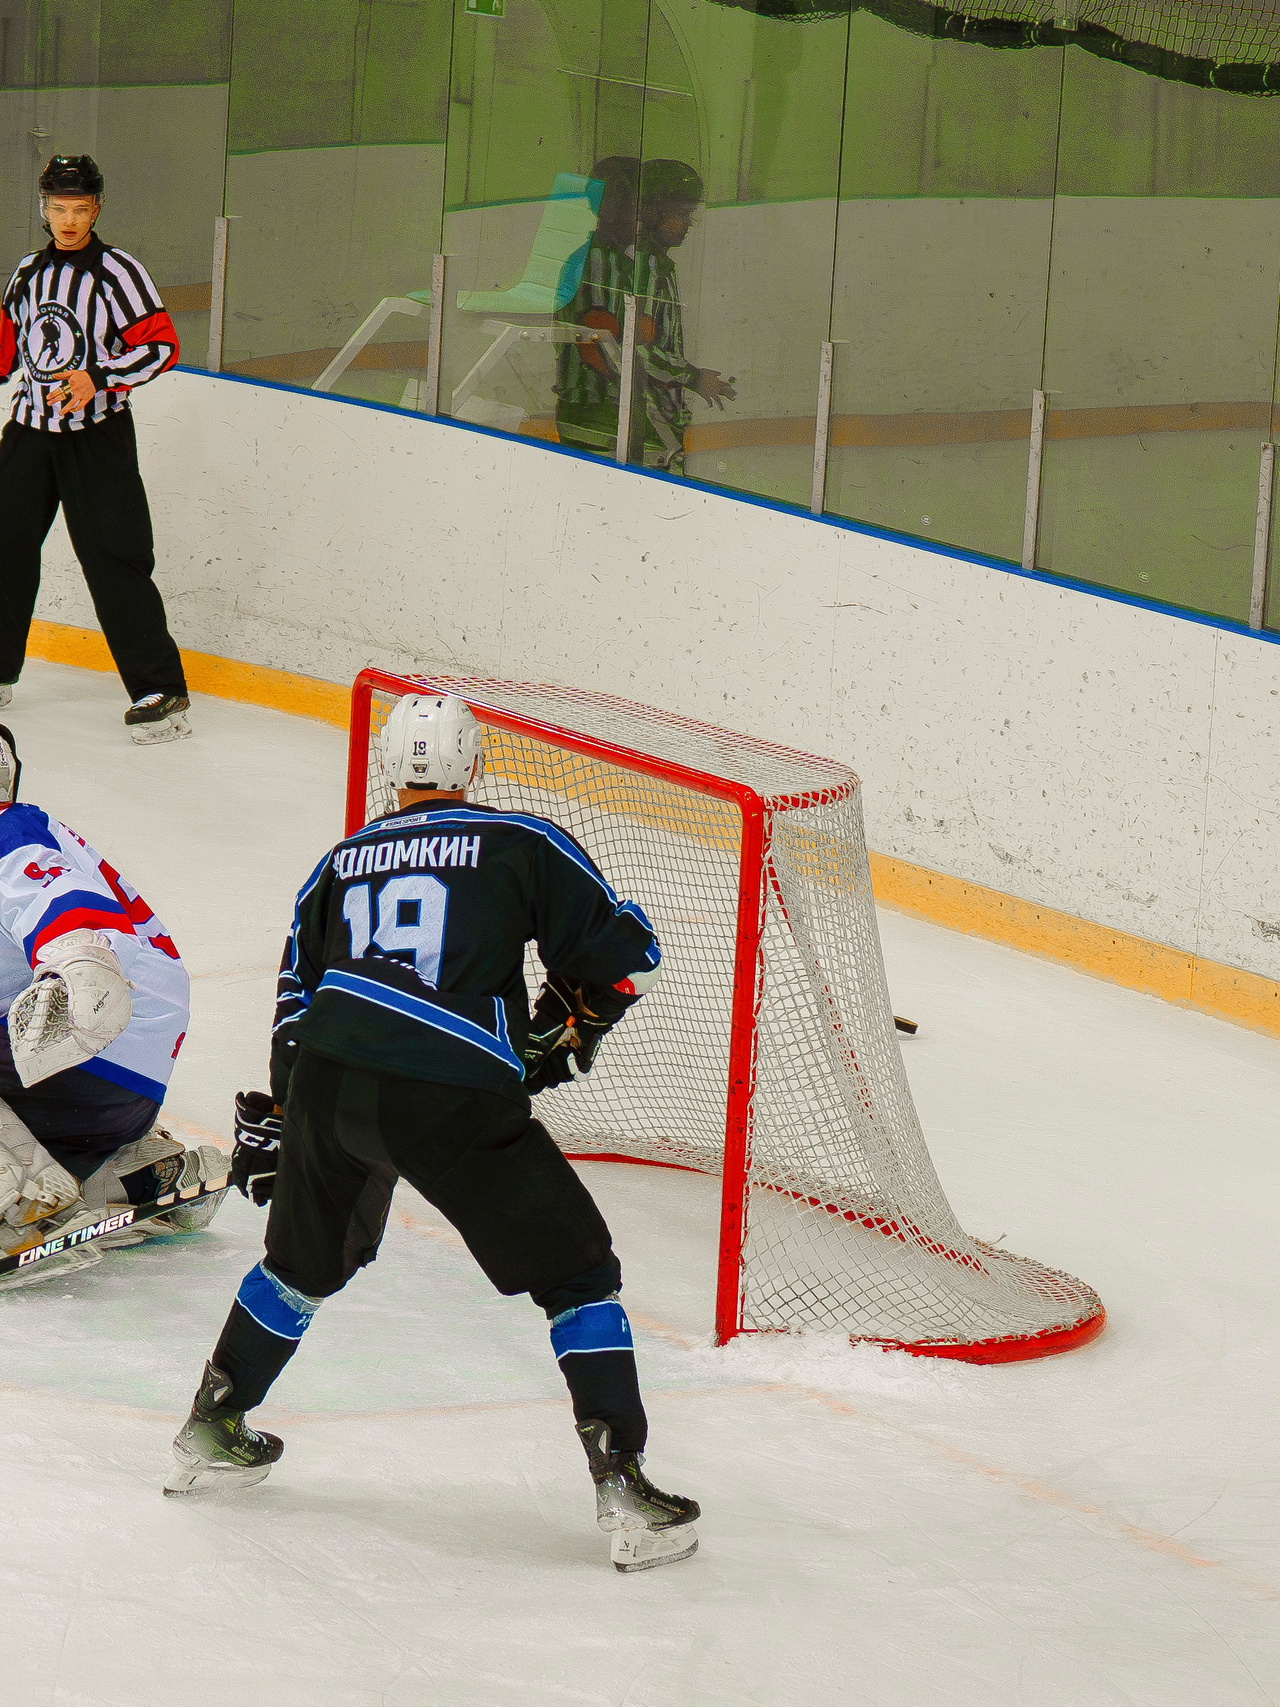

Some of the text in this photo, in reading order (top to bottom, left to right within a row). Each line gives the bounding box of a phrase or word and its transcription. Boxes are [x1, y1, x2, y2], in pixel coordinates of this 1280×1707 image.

[413, 741, 427, 756] 19
[342, 873, 450, 988] 19
[18, 1209, 135, 1267] ONE TIMER
